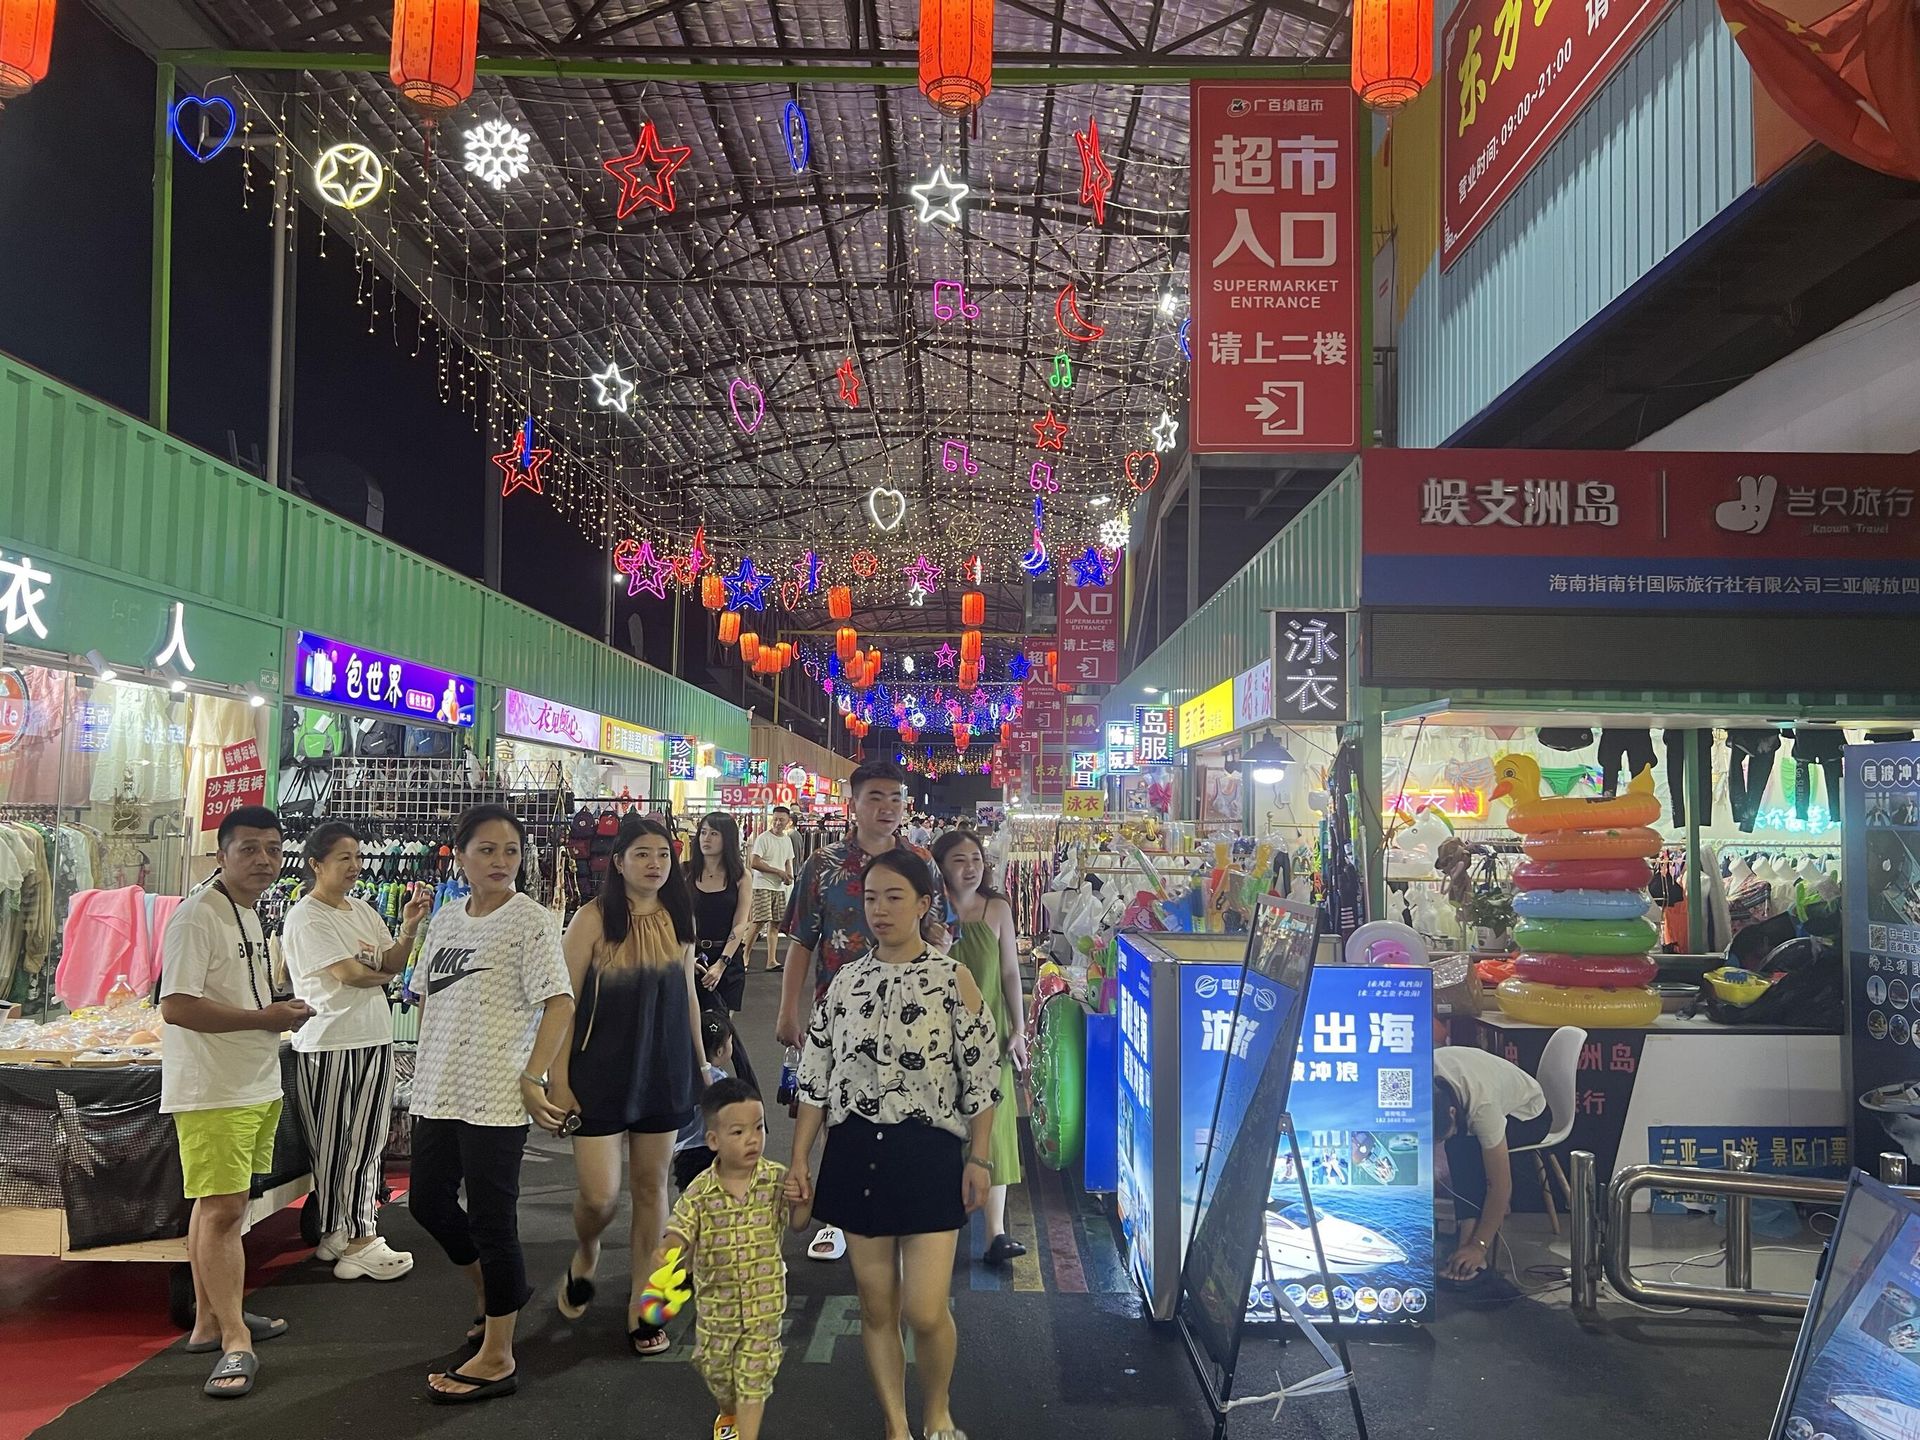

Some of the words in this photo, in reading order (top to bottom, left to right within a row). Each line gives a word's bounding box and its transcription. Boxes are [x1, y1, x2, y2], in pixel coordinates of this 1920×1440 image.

[1459, 0, 1550, 138] 东方
[1253, 99, 1324, 112] 广百纳超市
[1459, 136, 1499, 204] 营业时间:
[1501, 37, 1572, 146] 09:00~21:00
[1212, 134, 1339, 195] 超市
[1212, 208, 1337, 268] 入口
[1212, 279, 1339, 292] SUPERMARKET
[1230, 296, 1321, 309] ENTRANCE
[1208, 331, 1347, 365] 请上二楼
[1421, 478, 1619, 527] 蜈支洲岛
[1787, 486, 1914, 517] 岂只旅行
[1812, 523, 1849, 533] Known
[1856, 523, 1889, 534] Travel
[1065, 592, 1113, 615] 入口
[156, 601, 195, 672] 人
[1063, 639, 1115, 653] 请上二楼
[346, 653, 402, 709] 包世界
[1284, 619, 1340, 713] 泳衣
[1026, 701, 1060, 710] 请上二楼
[1141, 709, 1169, 761] 岛服
[671, 739, 692, 776] 珍珠
[208, 774, 265, 798] 沙滩短裤
[206, 797, 243, 816] 39/件
[1067, 796, 1100, 812] 泳衣
[429, 947, 477, 974] NIKE
[1201, 1010, 1415, 1053] 游出海
[1771, 1137, 1848, 1167] 景区门票
